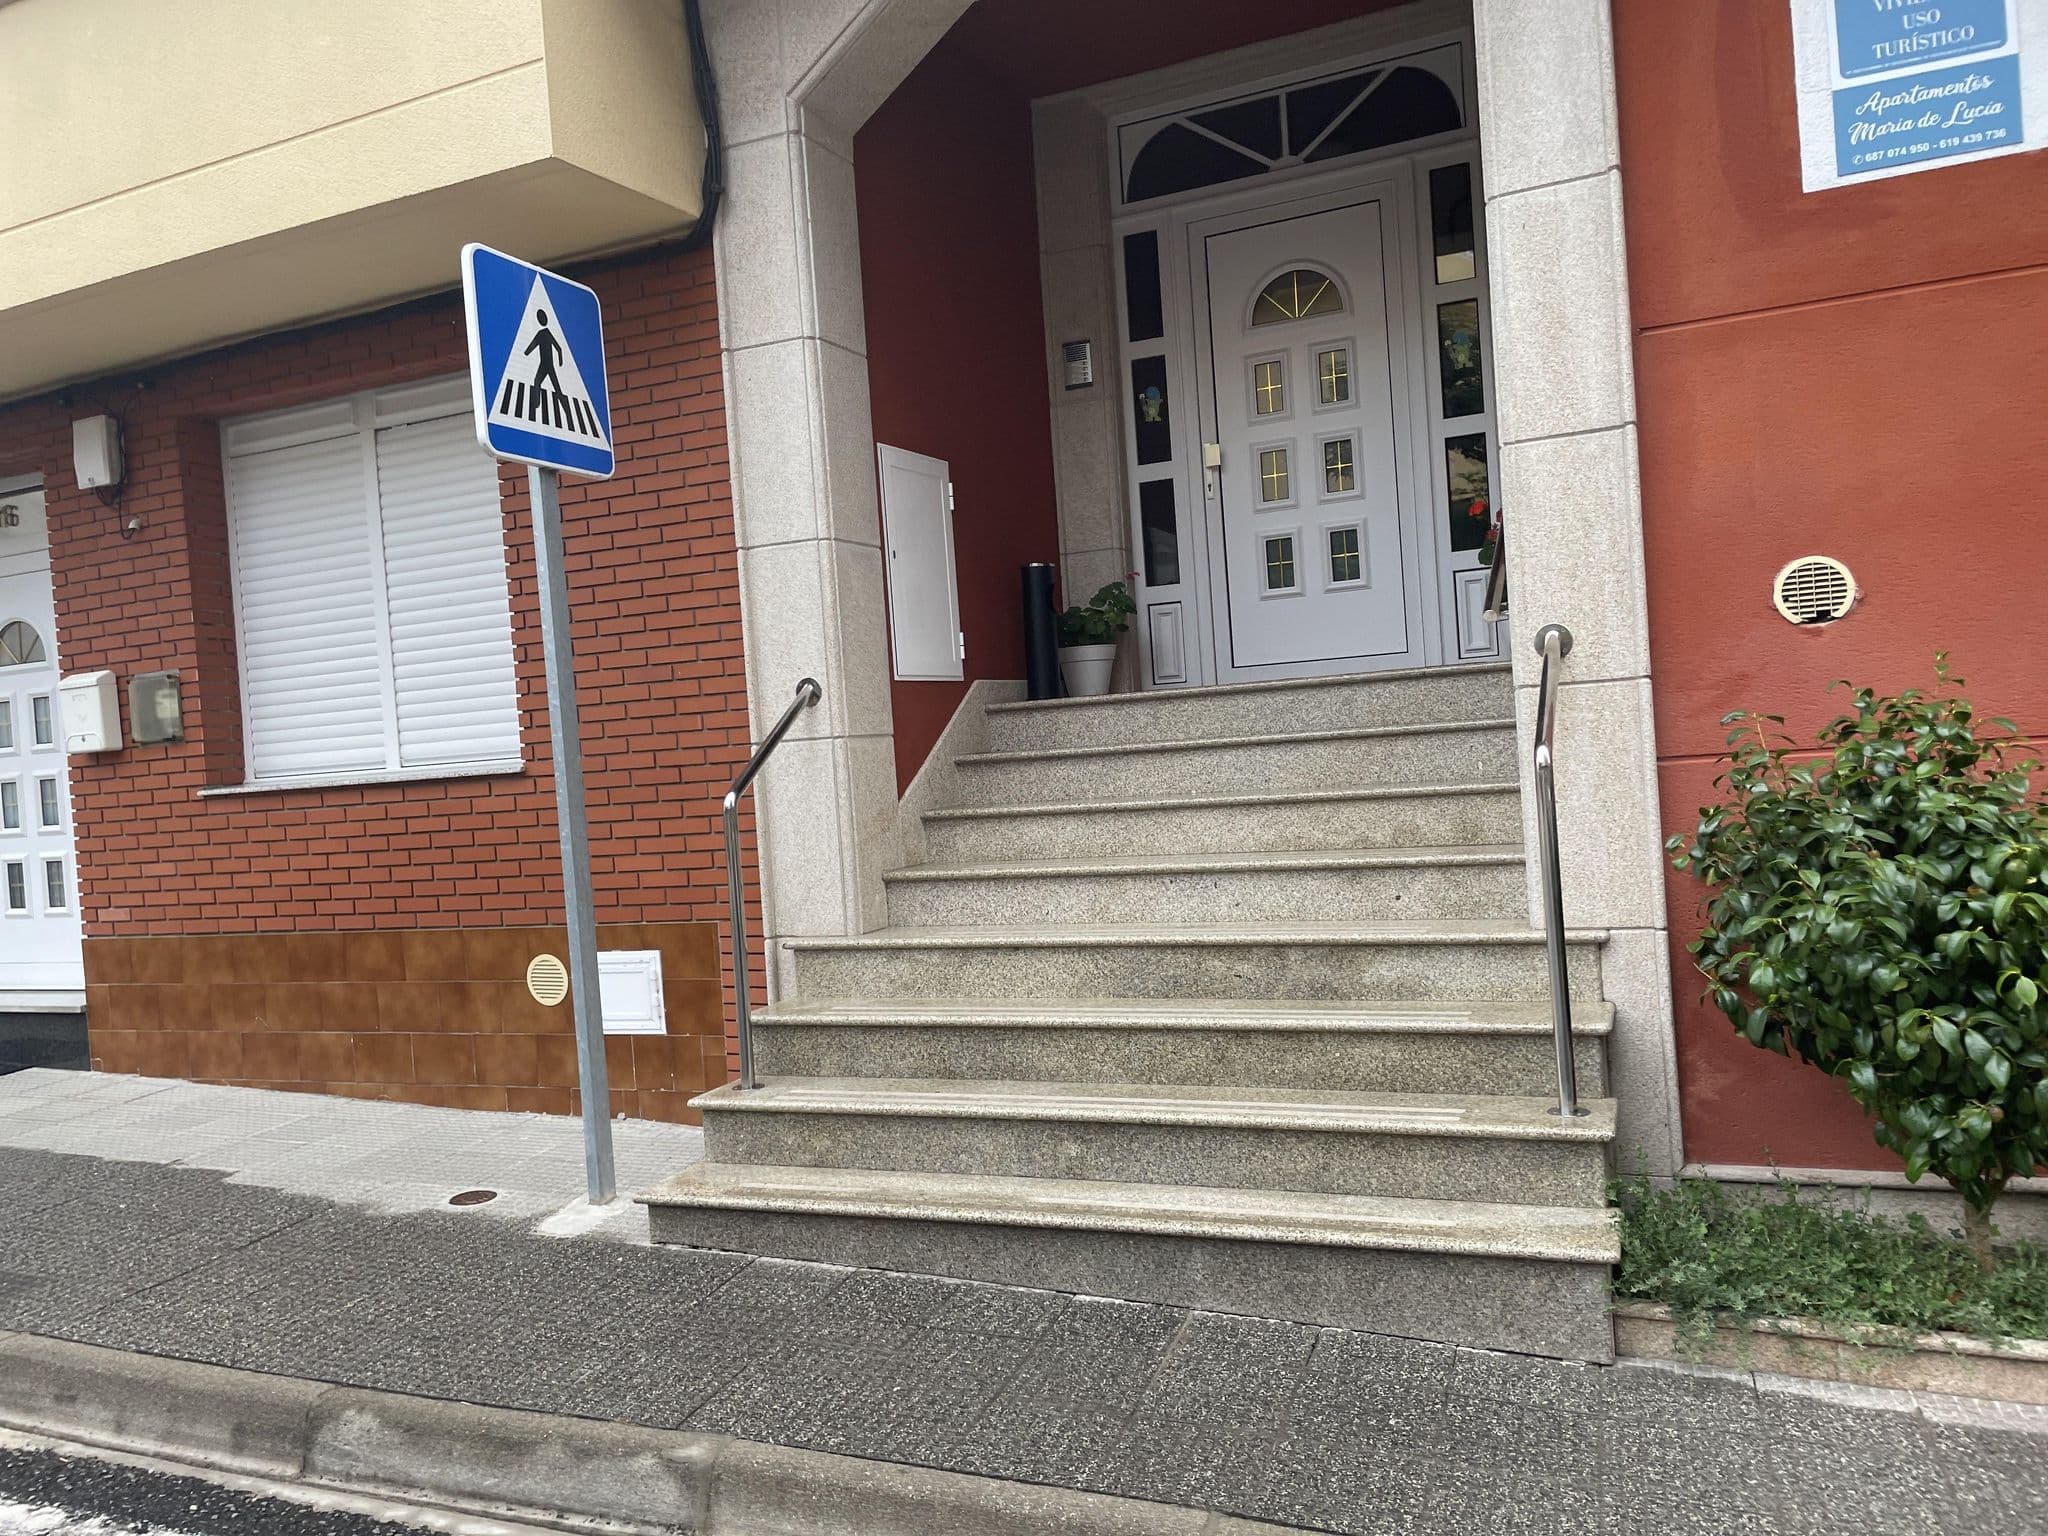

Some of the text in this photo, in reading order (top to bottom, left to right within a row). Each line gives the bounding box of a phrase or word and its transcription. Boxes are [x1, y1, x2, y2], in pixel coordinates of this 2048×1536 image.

[1902, 8, 1941, 30] USO
[1871, 24, 1975, 59] TURÍSTICO
[1855, 73, 1995, 116] Apartamentos
[1914, 111, 1941, 128] de
[1909, 142, 1930, 154] 950
[1939, 136, 1960, 149] 619
[1962, 132, 1983, 143] 439
